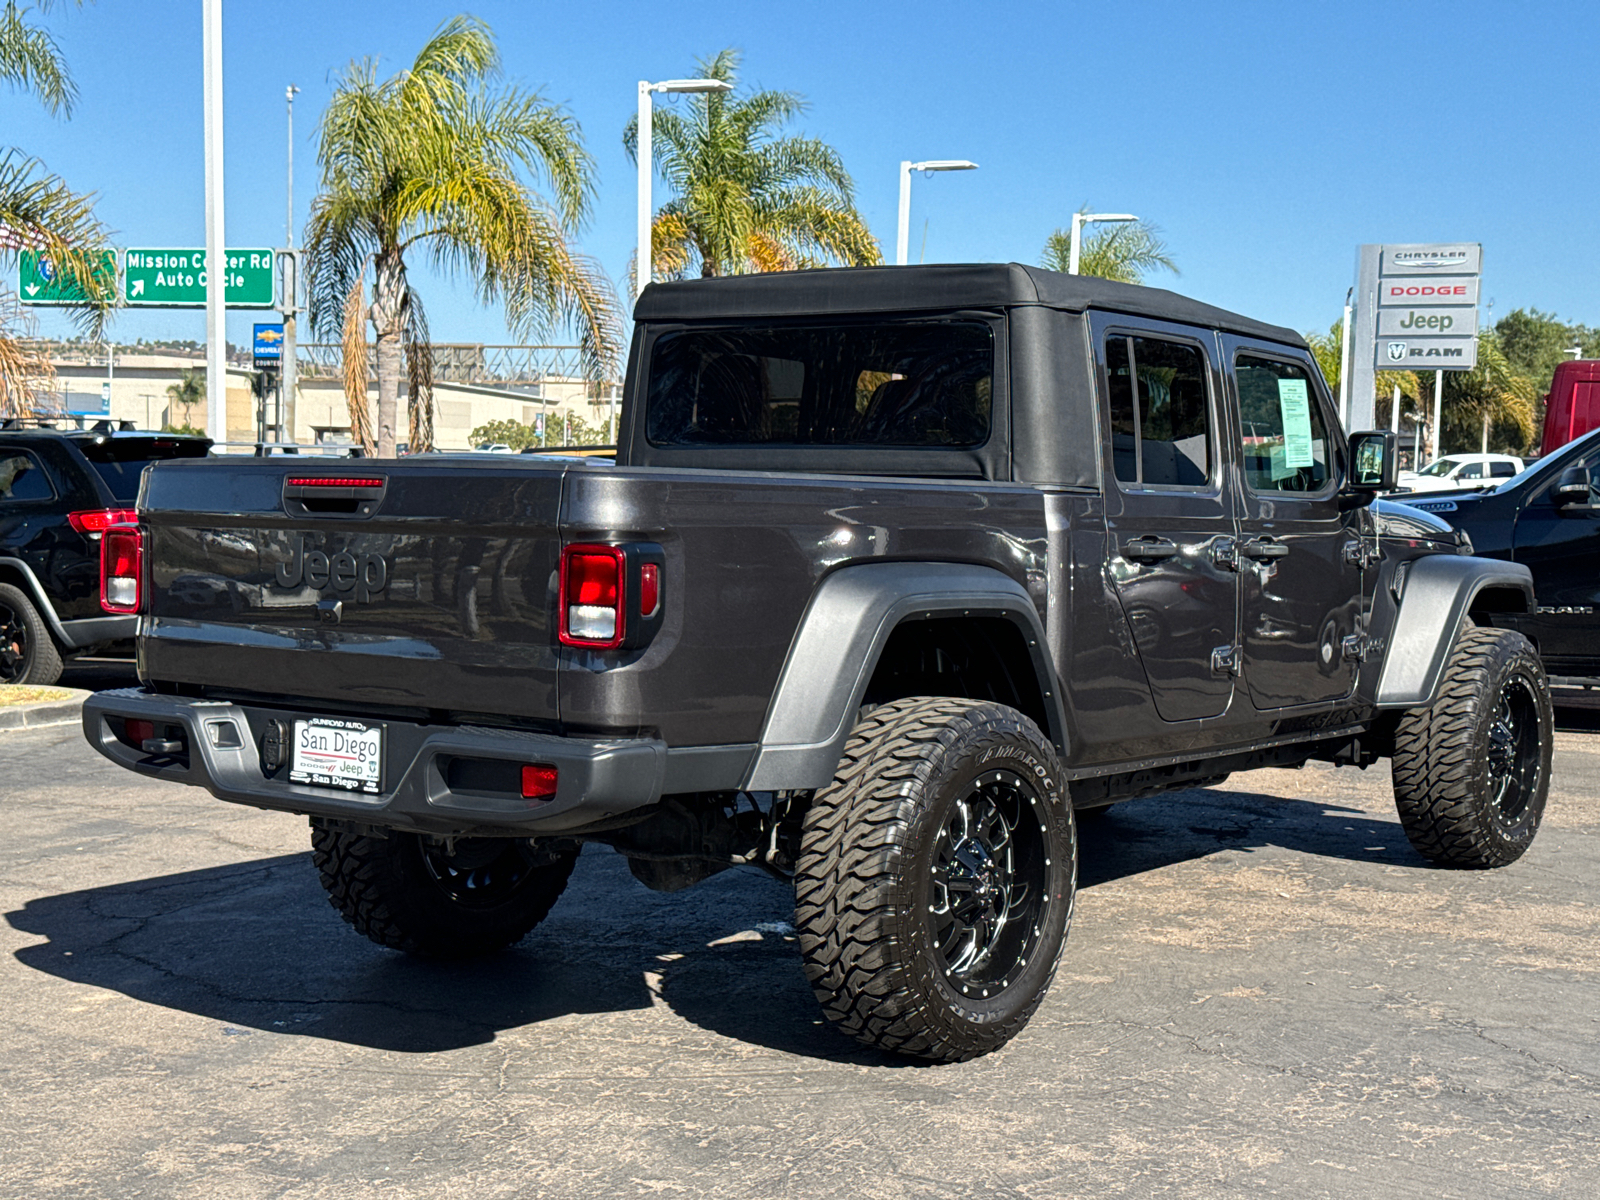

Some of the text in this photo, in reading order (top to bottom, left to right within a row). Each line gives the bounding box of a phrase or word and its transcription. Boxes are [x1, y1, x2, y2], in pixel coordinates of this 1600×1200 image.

[128, 253, 188, 268] Mission
[250, 253, 271, 269] Rd
[155, 271, 245, 287] Auto Ccle
[1390, 286, 1467, 296] DODGE
[1400, 311, 1453, 332] Jeep
[1409, 348, 1463, 357] RAM
[275, 536, 387, 605] Jeep
[1536, 606, 1593, 614] RAM
[345, 721, 362, 729] AUTO
[301, 728, 377, 762] San Diego
[340, 761, 363, 776] Jeep
[312, 774, 330, 784] San
[332, 775, 358, 789] Diego
